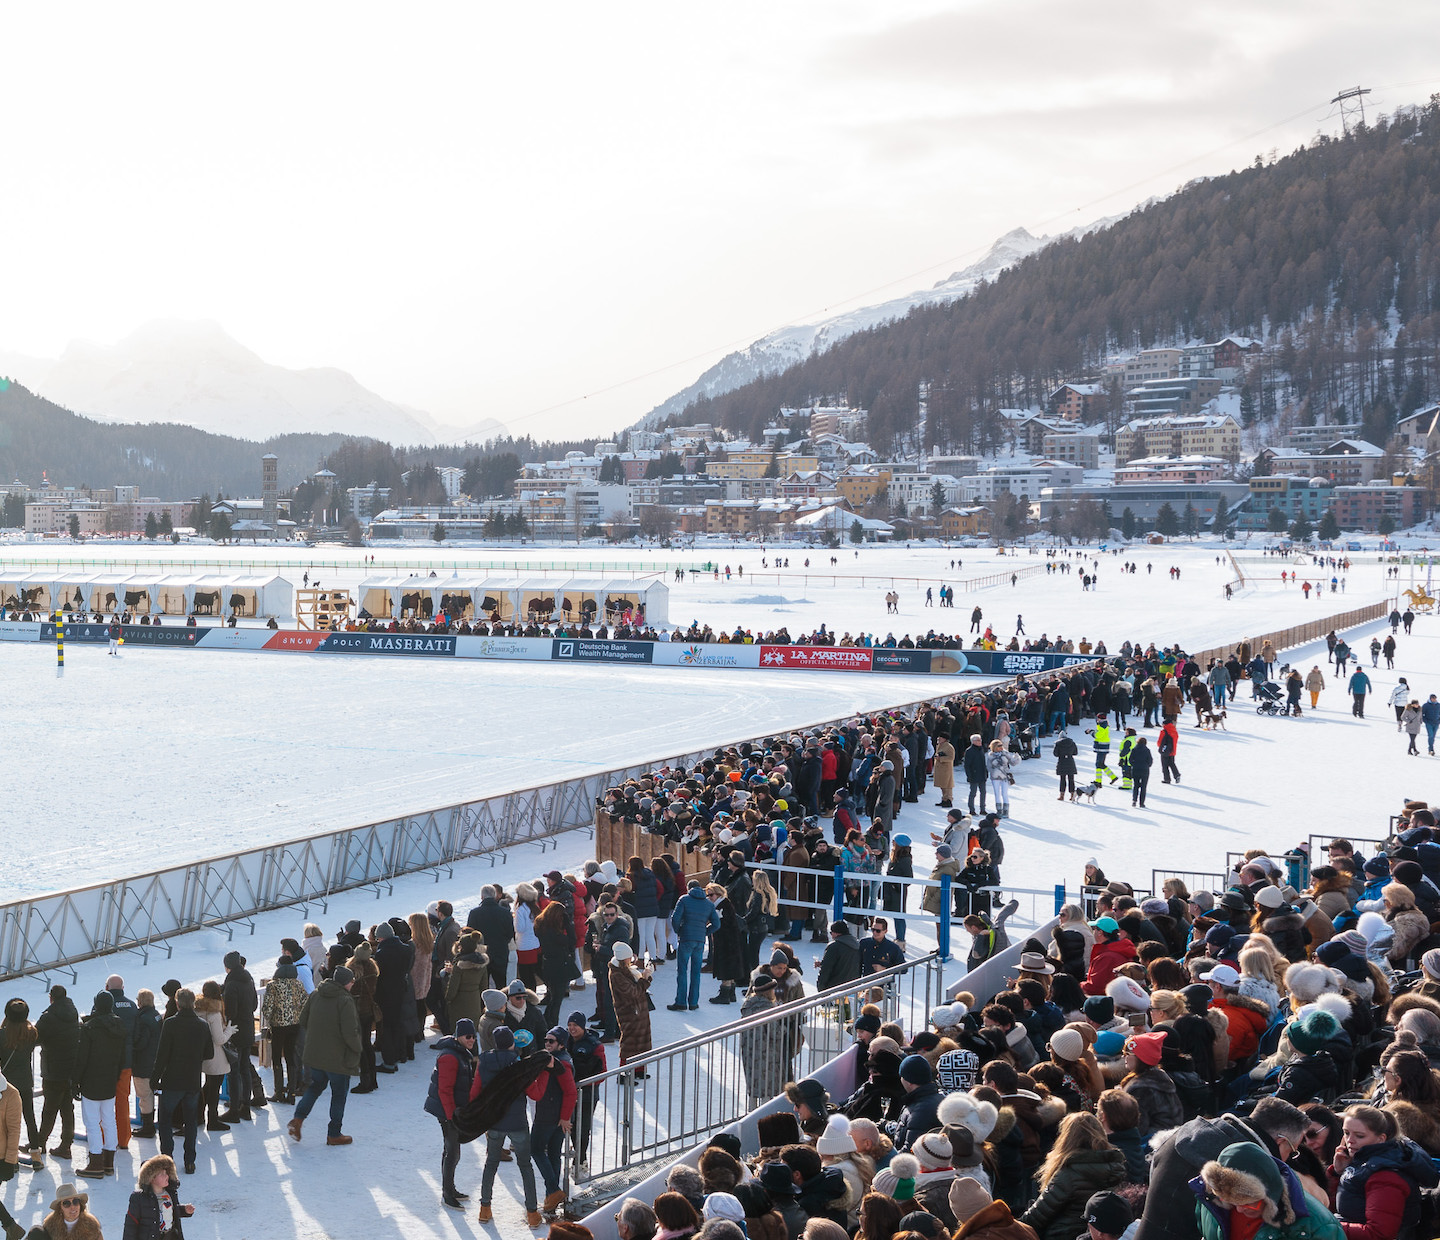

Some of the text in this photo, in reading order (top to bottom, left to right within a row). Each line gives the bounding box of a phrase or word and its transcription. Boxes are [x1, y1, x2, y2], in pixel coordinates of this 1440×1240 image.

[158, 632, 186, 640] OONA
[283, 637, 313, 645] SNOW
[369, 638, 452, 652] MASERATI
[602, 651, 645, 659] Management
[791, 651, 870, 662] LA MARTINA
